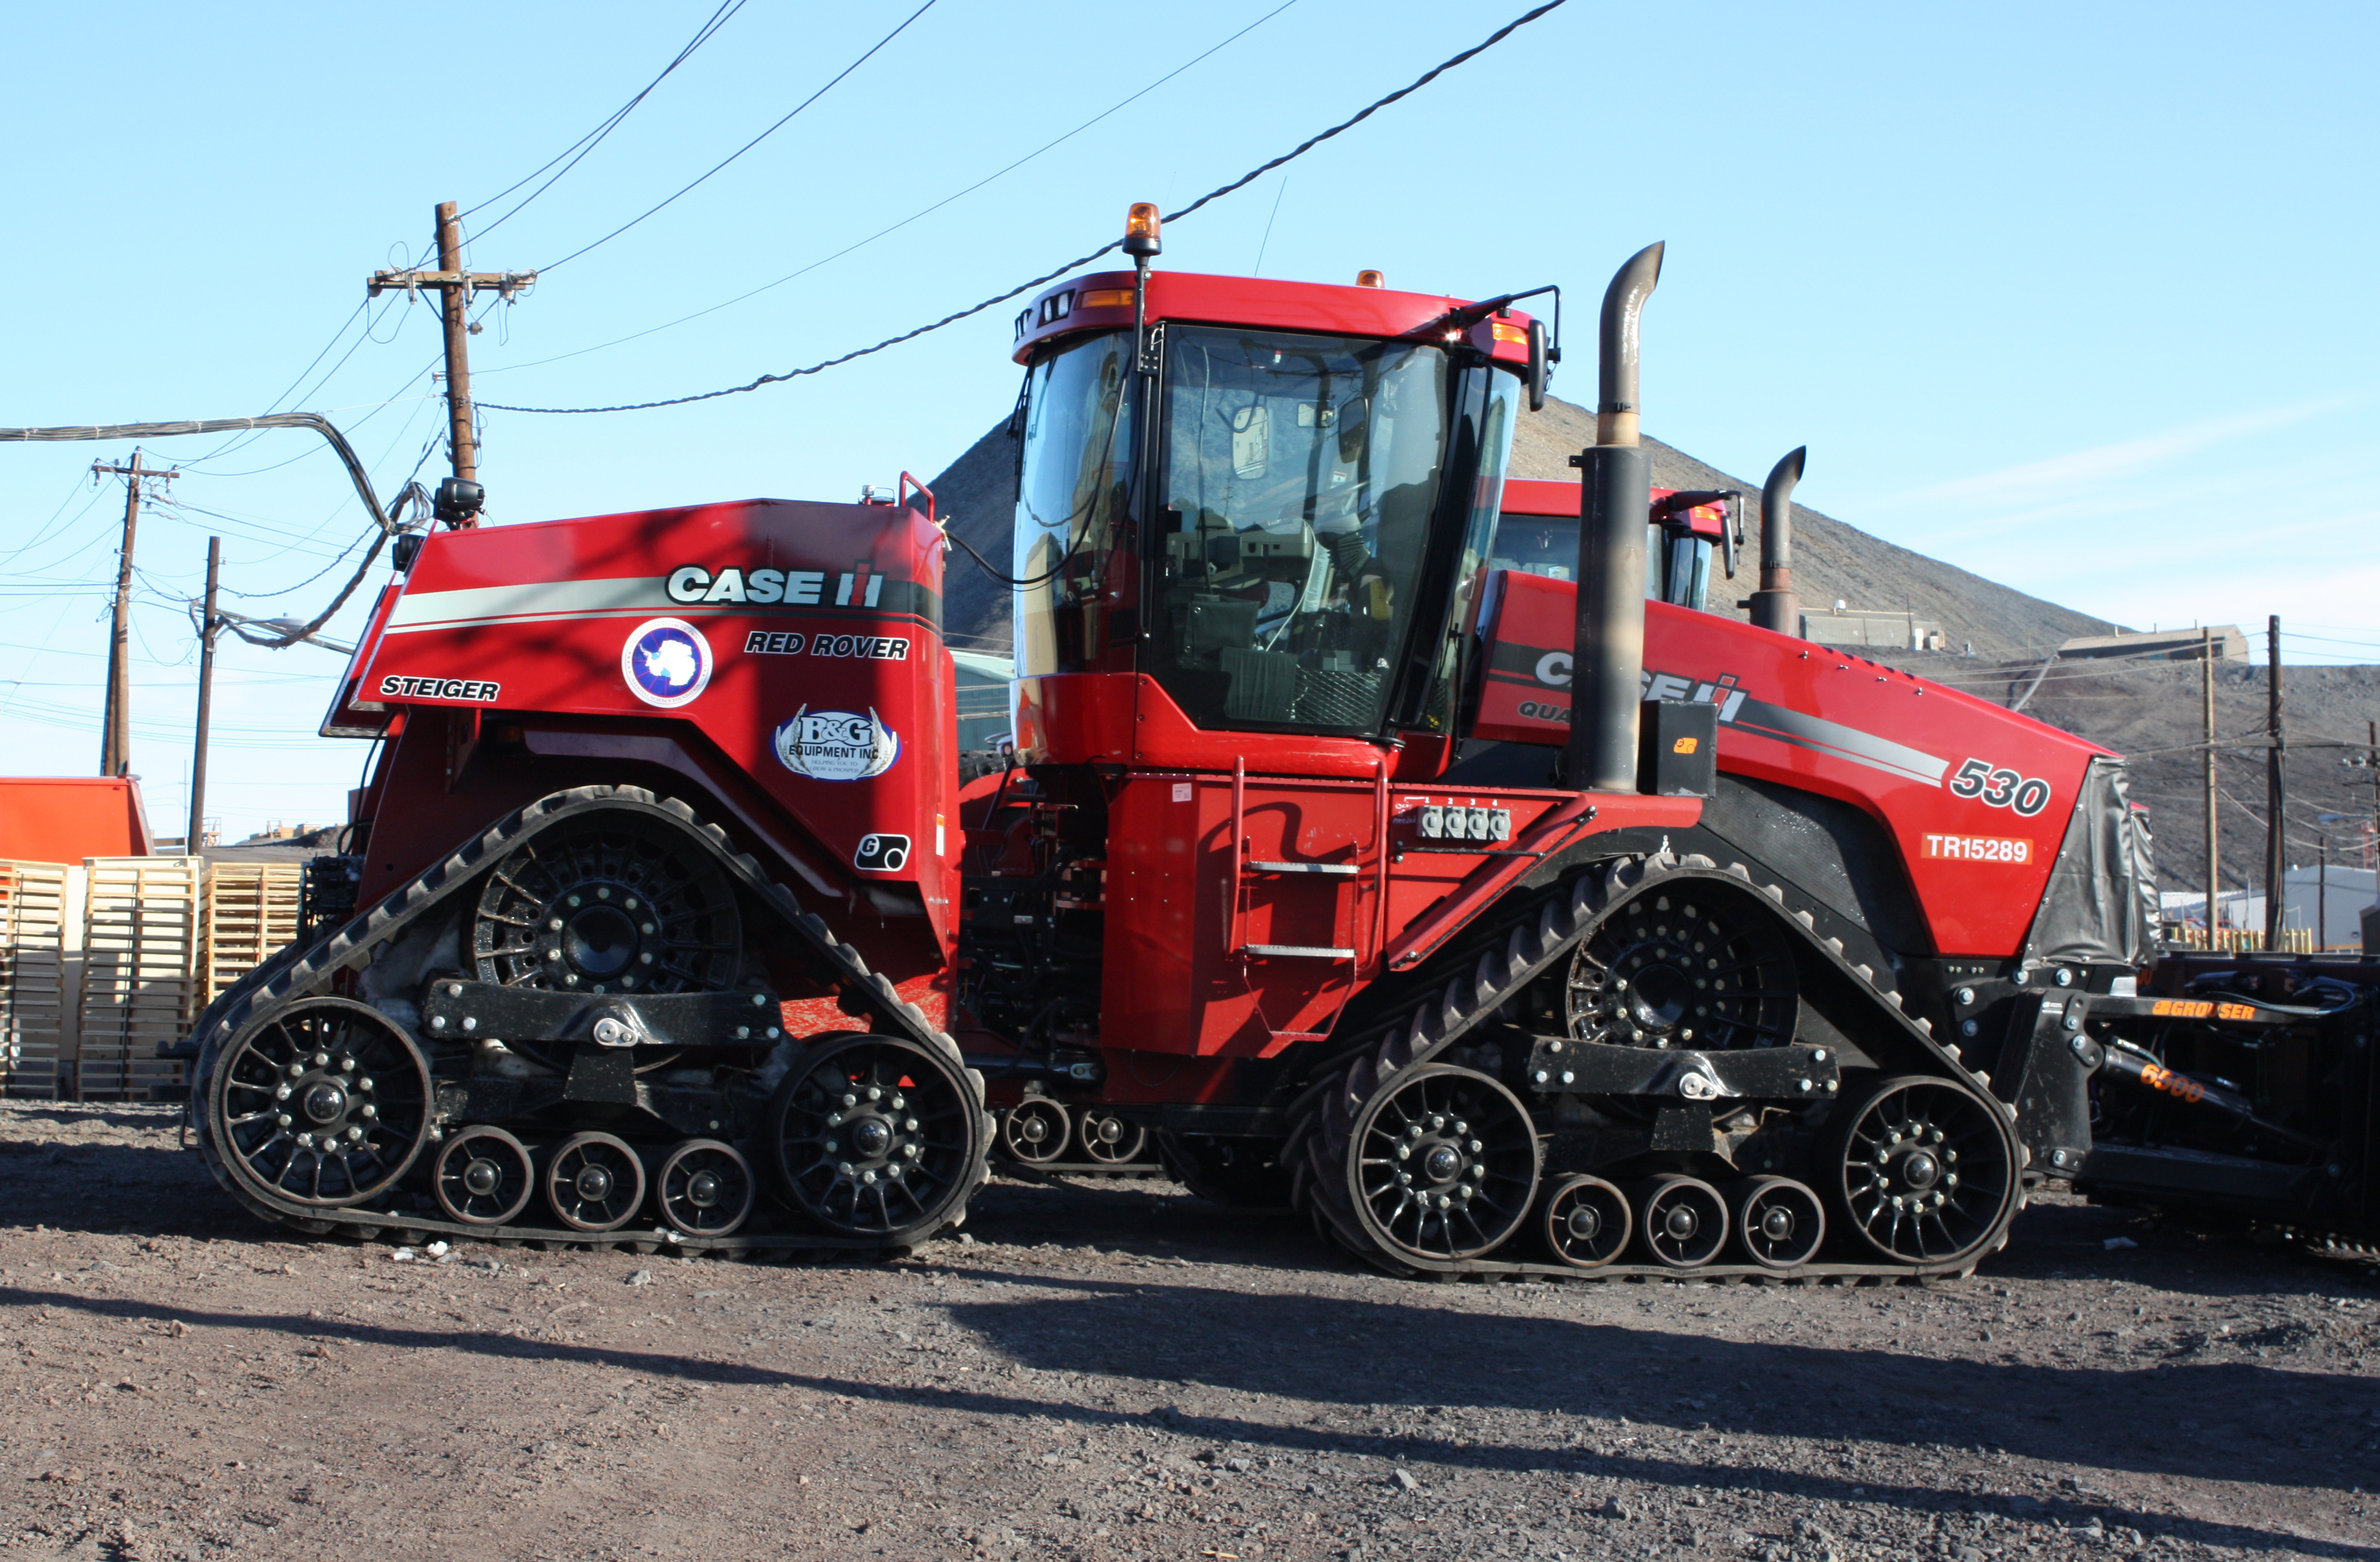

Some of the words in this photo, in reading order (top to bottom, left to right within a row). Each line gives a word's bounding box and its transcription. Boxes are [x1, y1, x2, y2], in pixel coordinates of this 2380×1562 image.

[668, 566, 825, 604] CASE
[744, 631, 806, 654] RED
[810, 634, 910, 661] ROVER
[379, 674, 501, 702] STEIGER
[630, 678, 650, 698] NATIONAL
[650, 695, 672, 703] SCIENCE
[672, 683, 701, 703] FOUNDATION
[799, 716, 874, 748] B&G
[789, 745, 857, 759] EQUIPMENT
[859, 748, 882, 760] INC.
[1949, 757, 2051, 817] 530
[1927, 834, 2028, 862] TR15289
[2170, 1000, 2257, 1020] GROUSER
[2140, 1064, 2205, 1103] 6500
